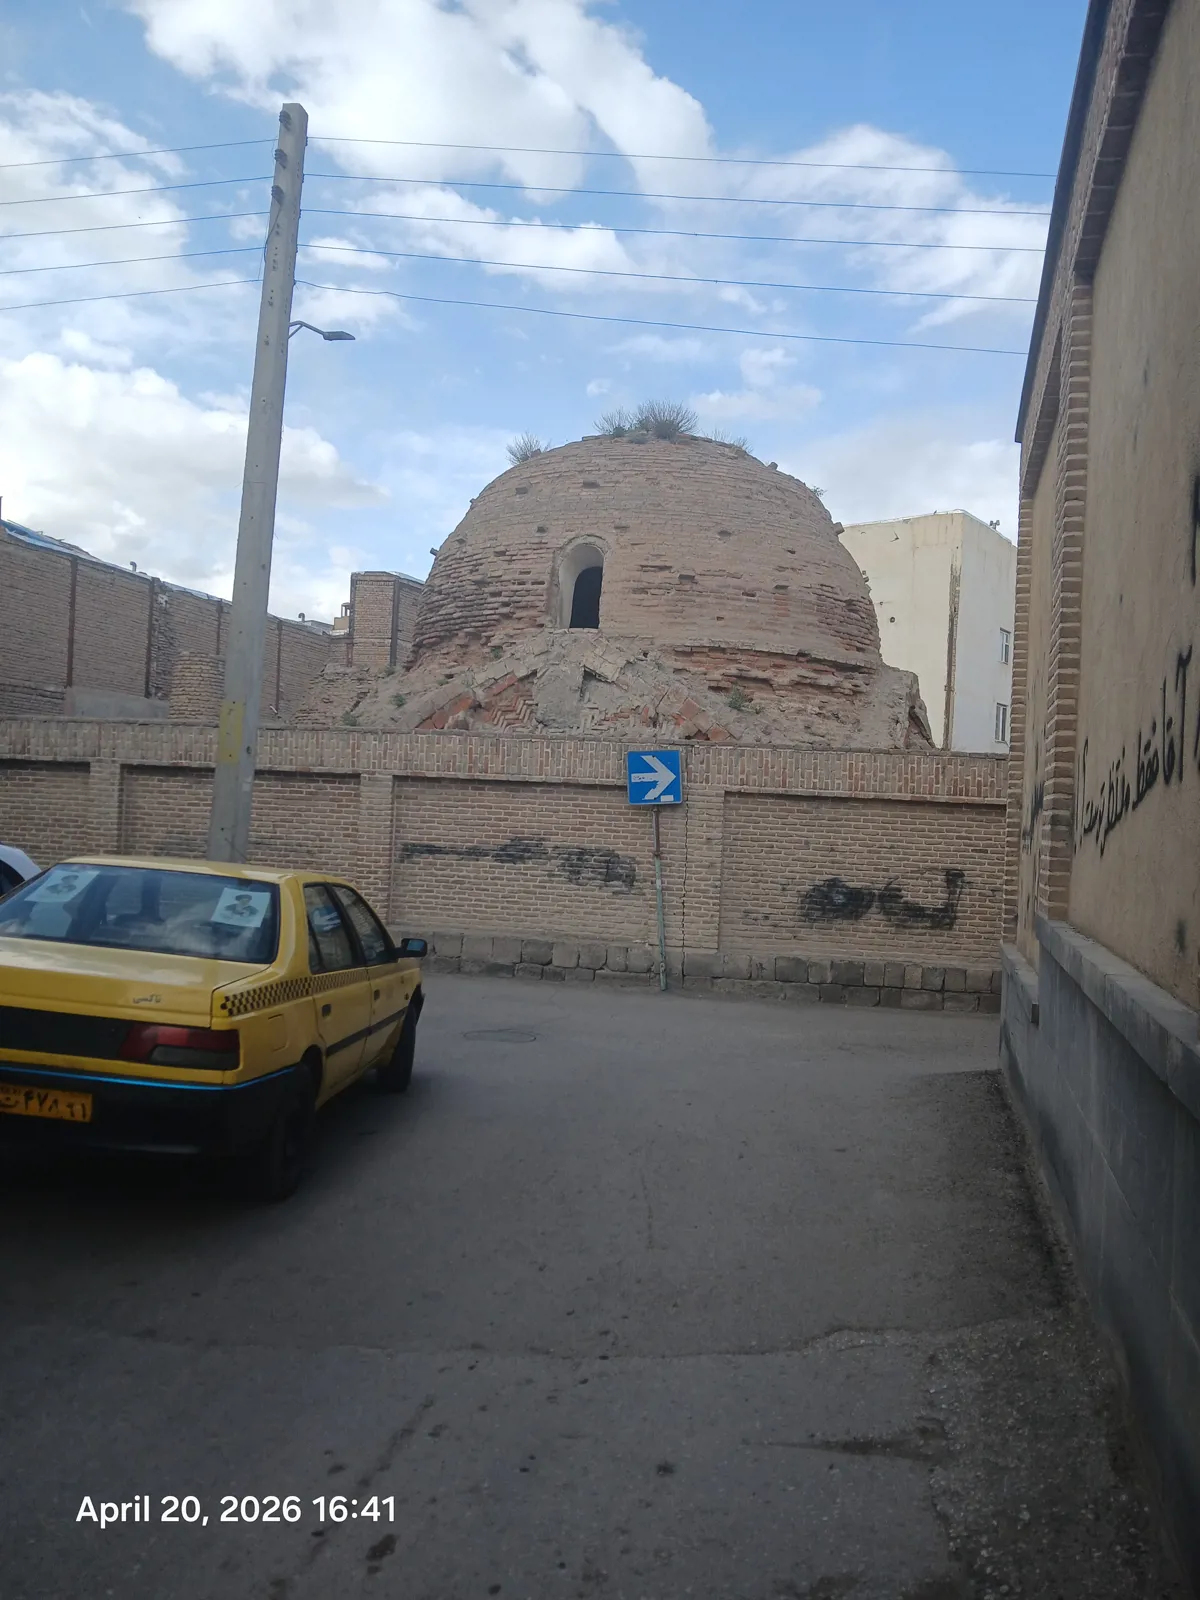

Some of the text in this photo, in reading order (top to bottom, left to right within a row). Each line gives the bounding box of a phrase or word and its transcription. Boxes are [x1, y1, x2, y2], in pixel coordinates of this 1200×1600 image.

[1131, 717, 1160, 812] فقط
[1161, 643, 1193, 787] آقا
[1099, 745, 1131, 858] منتظر
